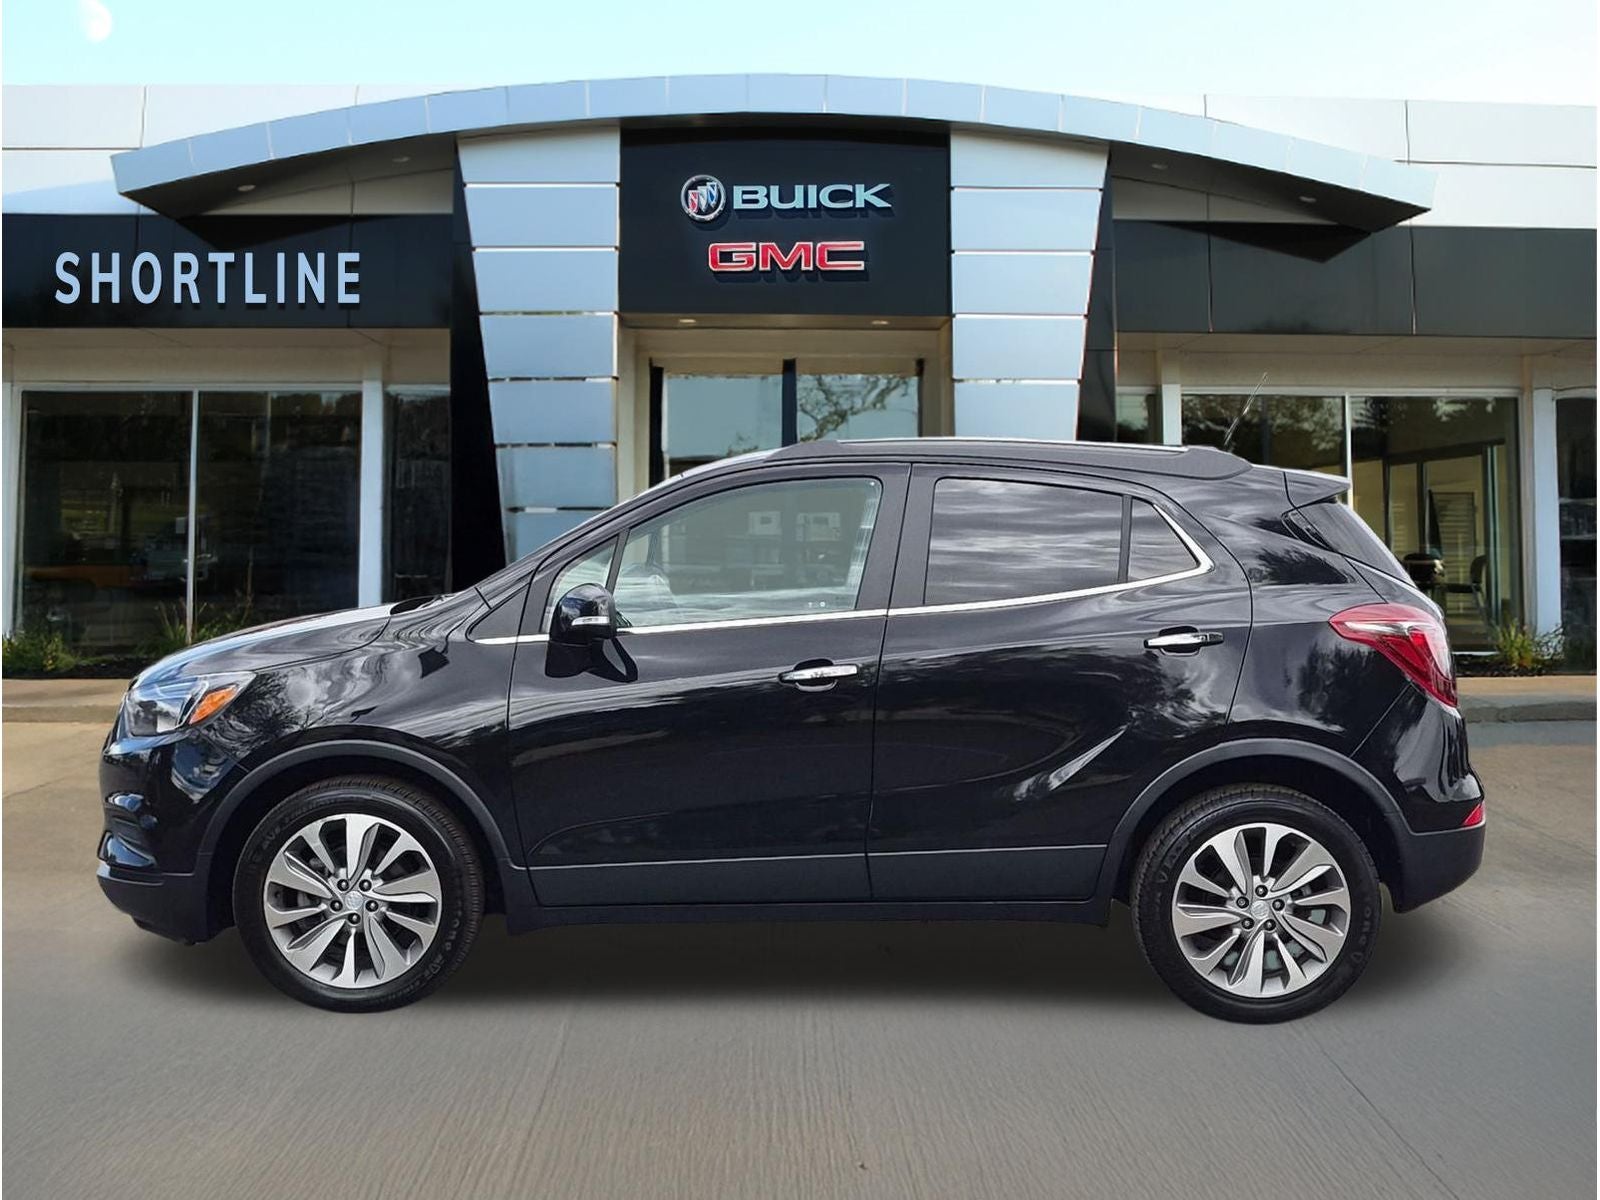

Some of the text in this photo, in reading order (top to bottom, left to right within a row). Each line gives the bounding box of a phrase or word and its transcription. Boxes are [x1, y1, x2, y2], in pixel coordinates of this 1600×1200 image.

[733, 183, 892, 210] BUICK
[708, 241, 865, 271] GMC
[55, 251, 362, 305] SHORTLINE
